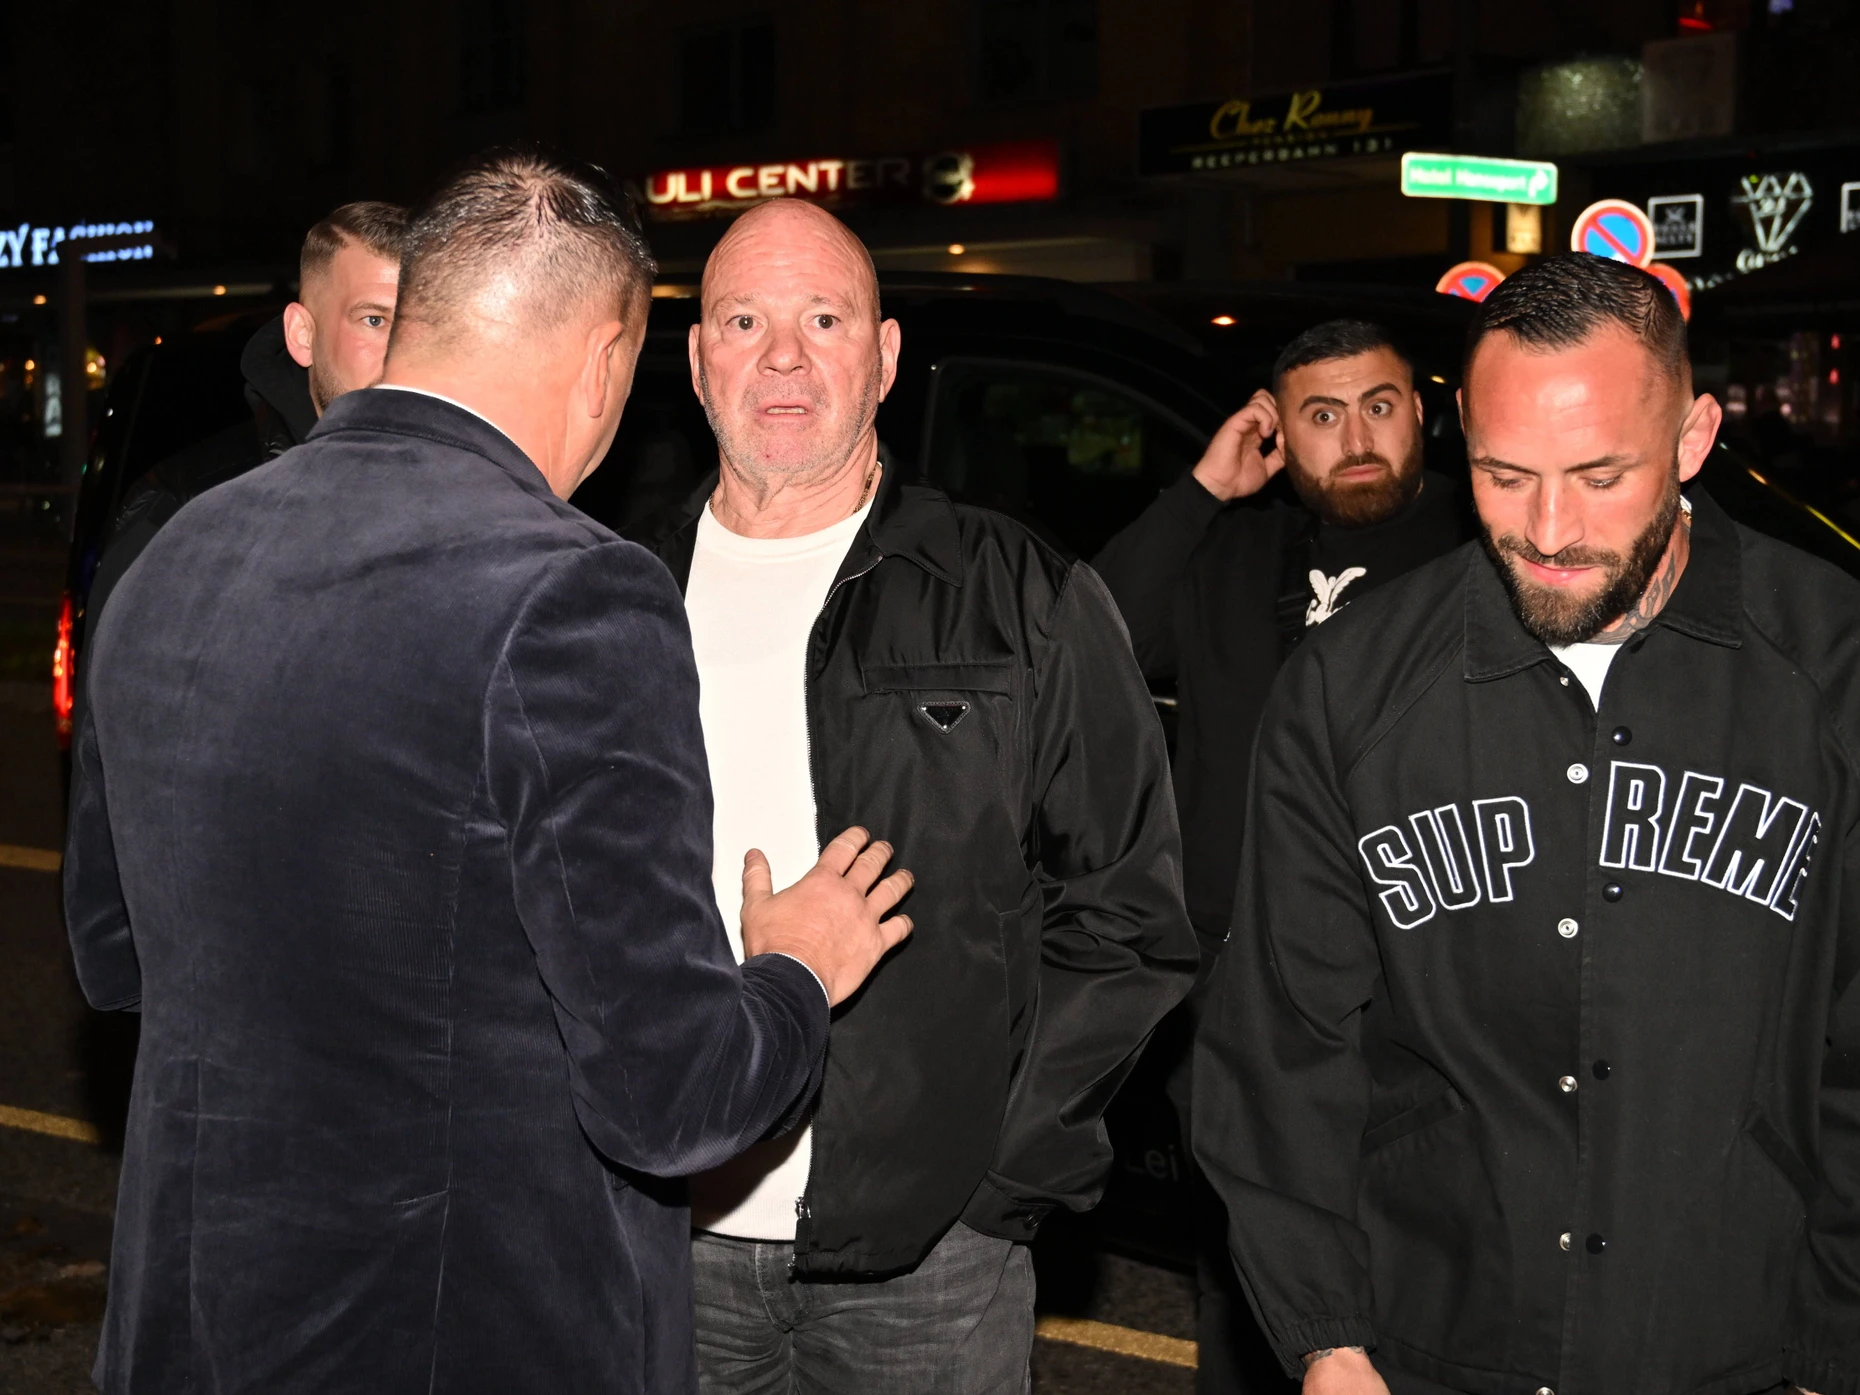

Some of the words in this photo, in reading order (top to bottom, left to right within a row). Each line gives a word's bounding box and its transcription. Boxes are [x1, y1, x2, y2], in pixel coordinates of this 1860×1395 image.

[1191, 144, 1338, 170] REEPERBAHN
[634, 168, 713, 205] ULI
[725, 156, 910, 199] CENTER
